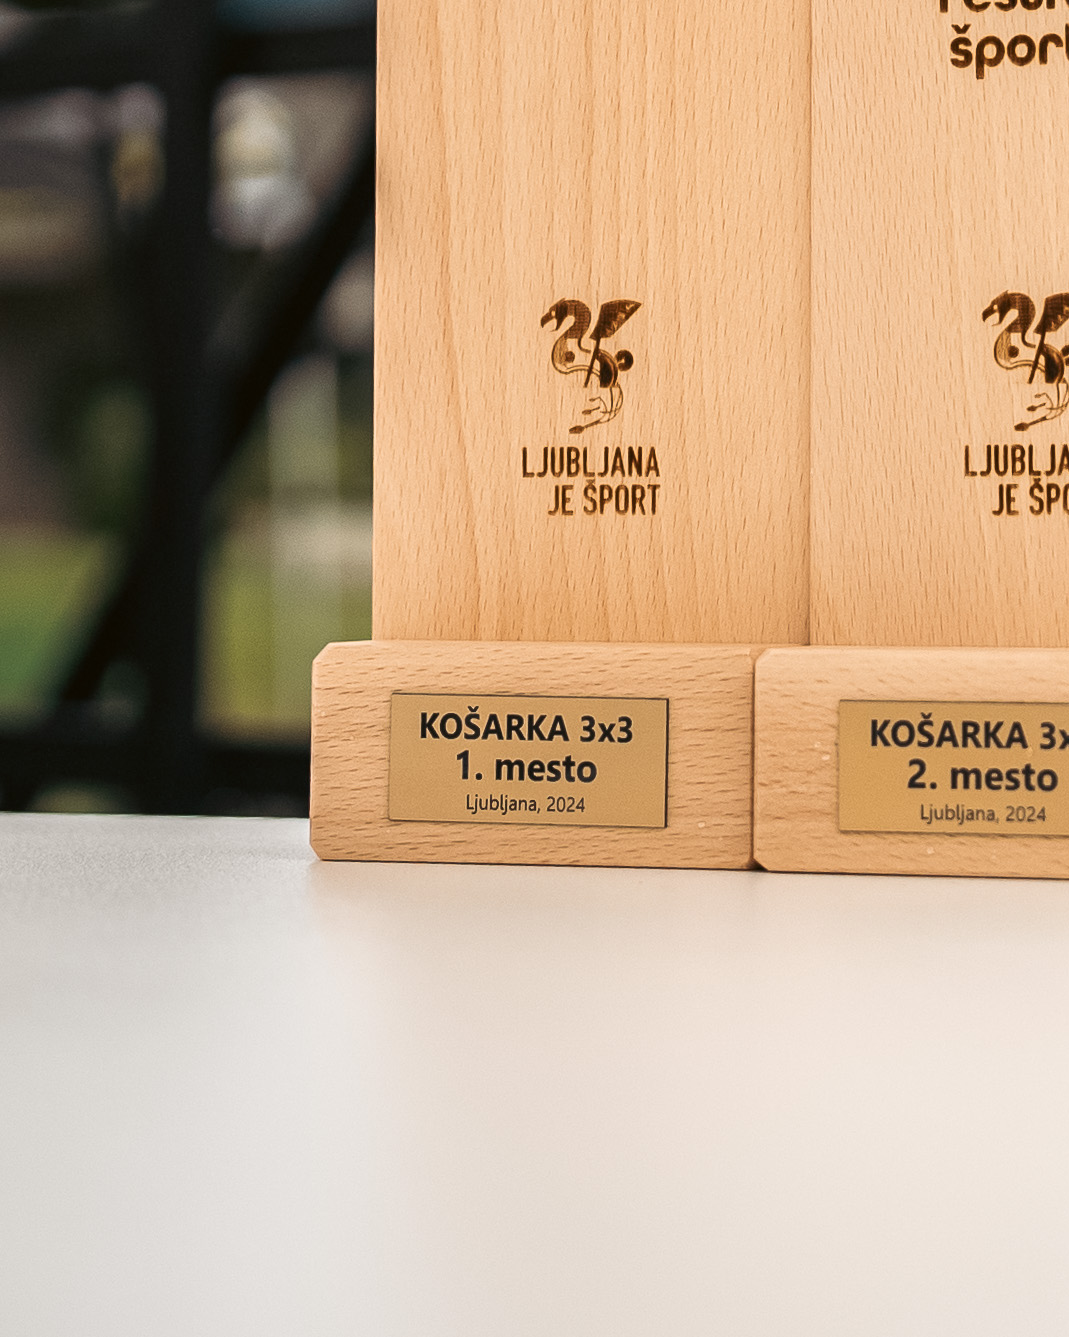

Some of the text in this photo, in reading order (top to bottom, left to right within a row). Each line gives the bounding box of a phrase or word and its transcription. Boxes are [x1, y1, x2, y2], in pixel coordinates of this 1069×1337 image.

[522, 445, 661, 478] LJUBLJANA
[547, 478, 661, 516] JE ŠPORT
[991, 483, 1019, 517] JE
[420, 705, 633, 744] KOŠARKA 3x3
[870, 712, 1029, 750] KOŠARKA
[456, 749, 598, 783] 1. mesto
[907, 758, 1059, 792] 2. mesto
[466, 793, 586, 816] Ljubljana, 2024
[920, 803, 1047, 826] Ljubljana, 2024
